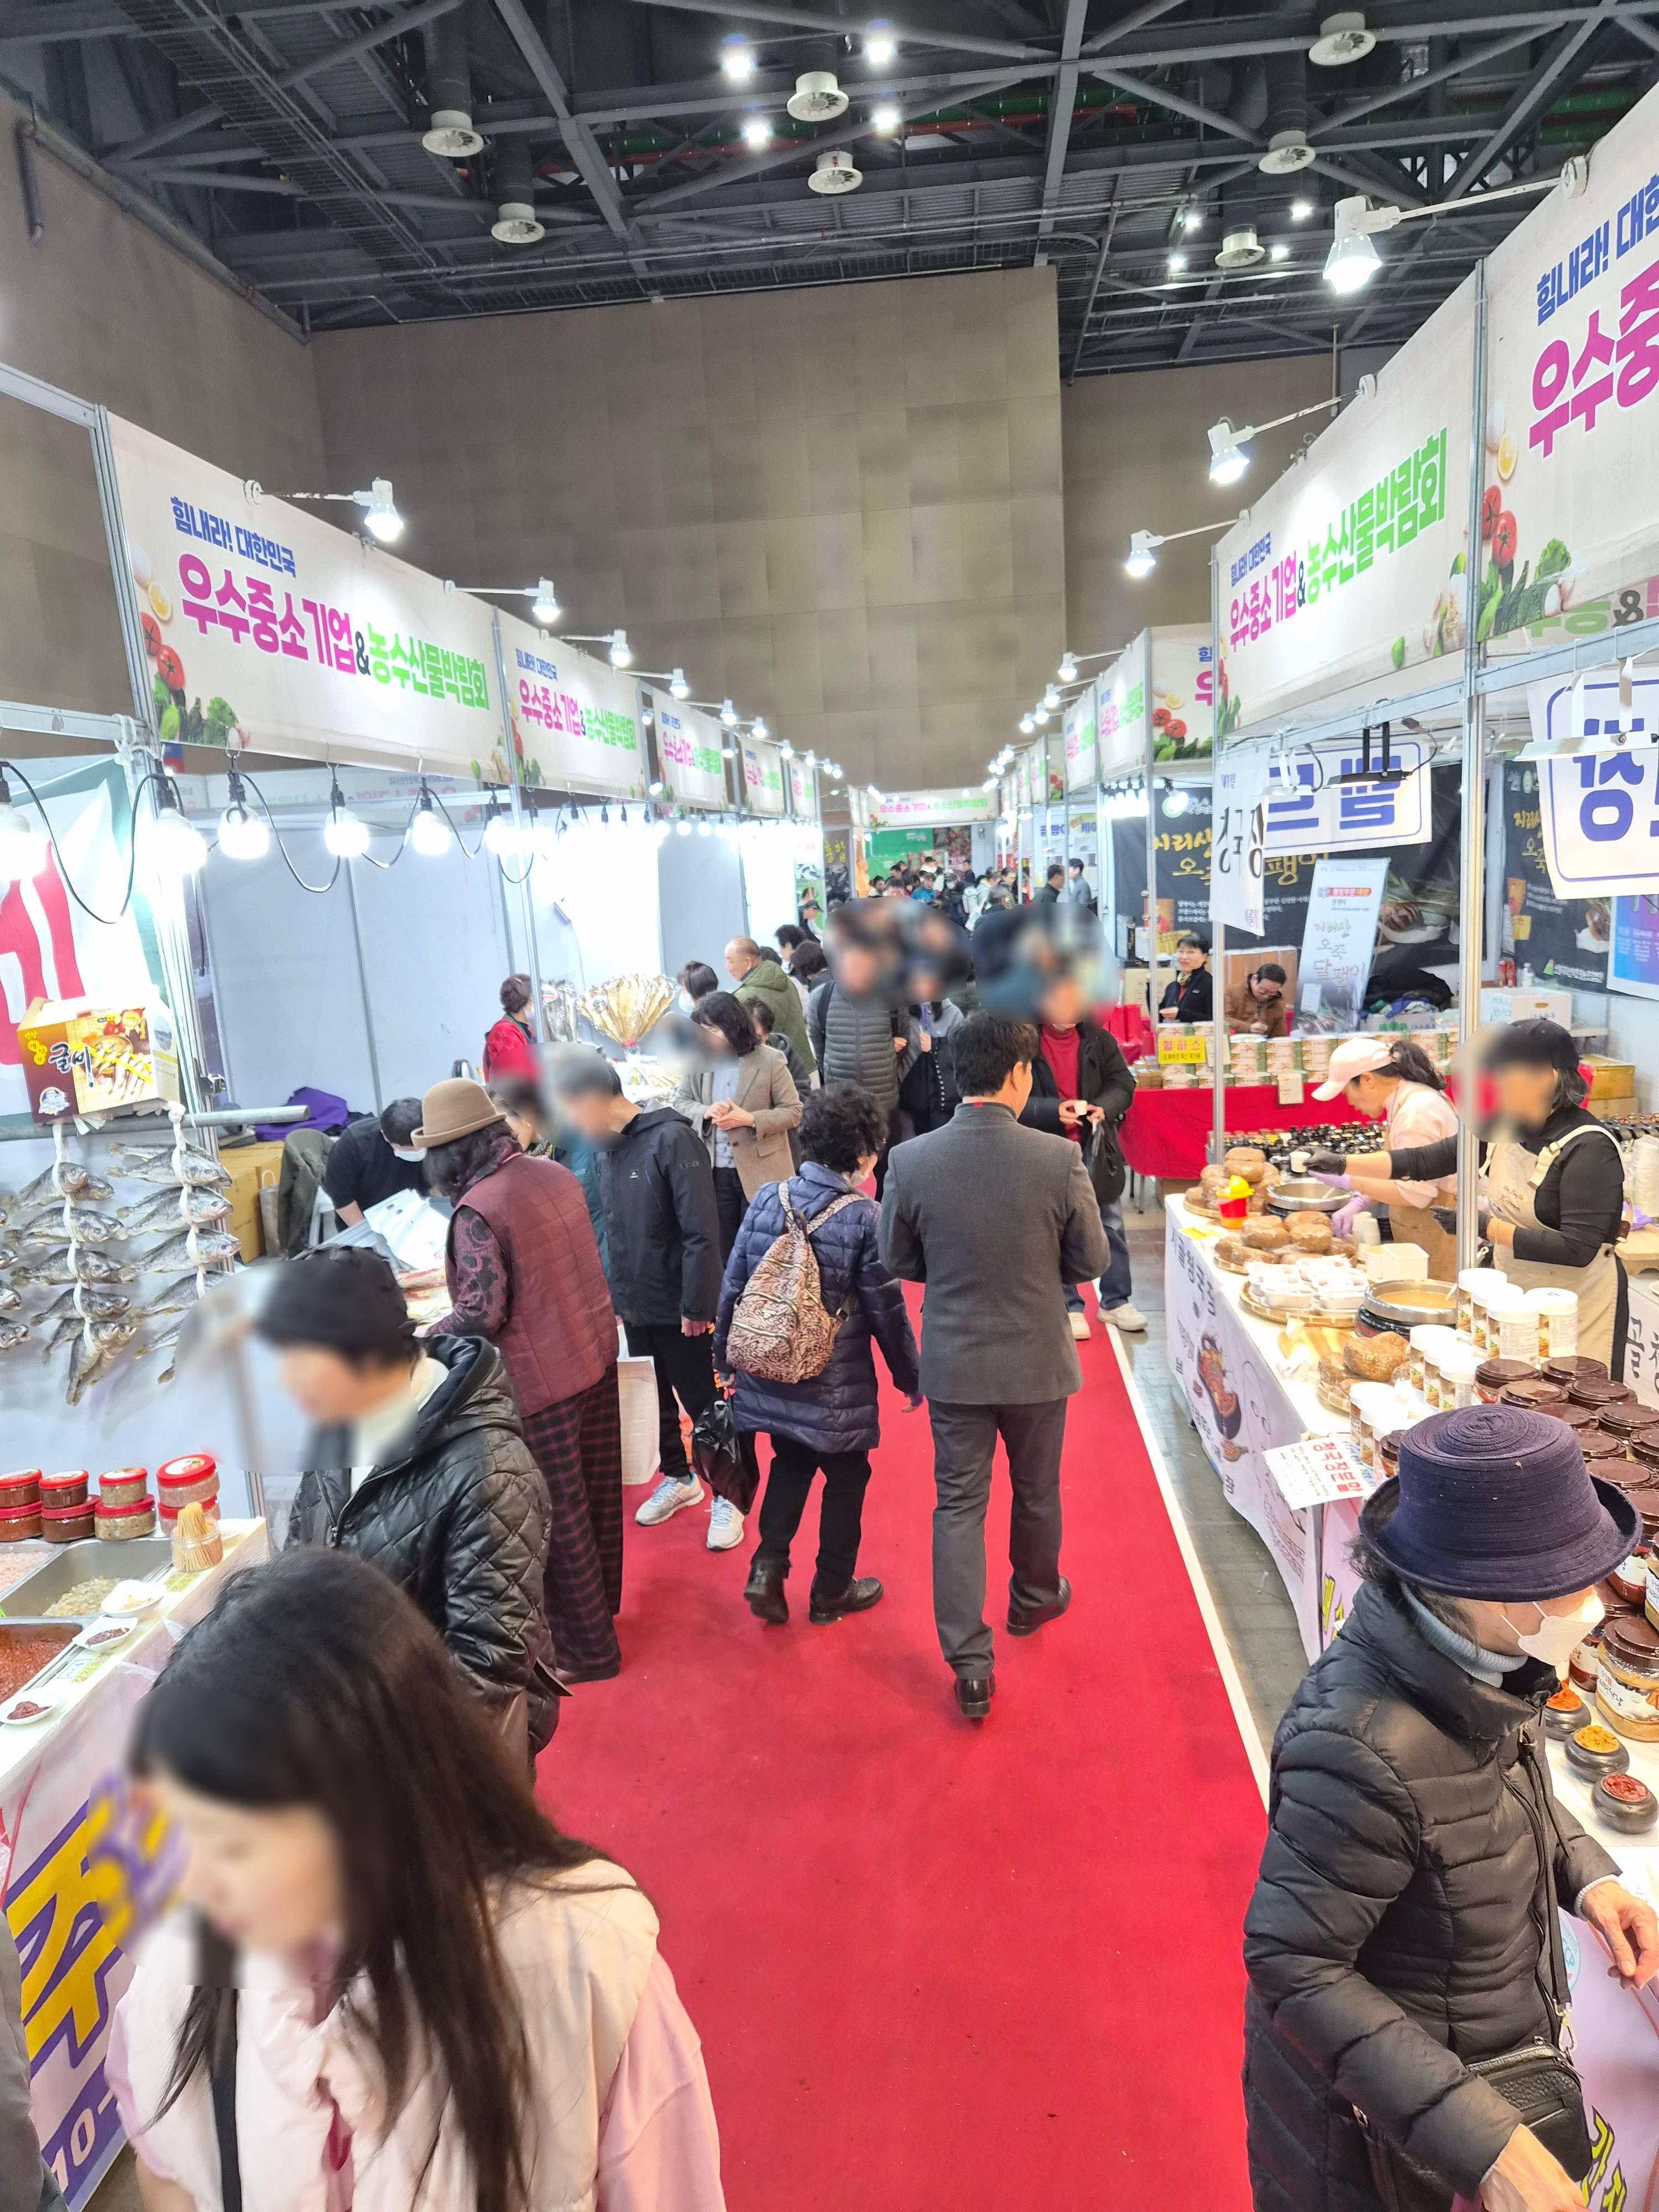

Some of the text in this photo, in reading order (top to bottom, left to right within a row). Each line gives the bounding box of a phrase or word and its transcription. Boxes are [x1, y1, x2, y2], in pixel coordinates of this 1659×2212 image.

[1537, 220, 1610, 327] 힘내라!
[169, 495, 296, 578] 힘내라! 대한민국
[1248, 531, 1271, 572] 대한민국
[49, 1042, 94, 1088] 굴비
[1313, 1442, 1364, 1493] 청국장분말
